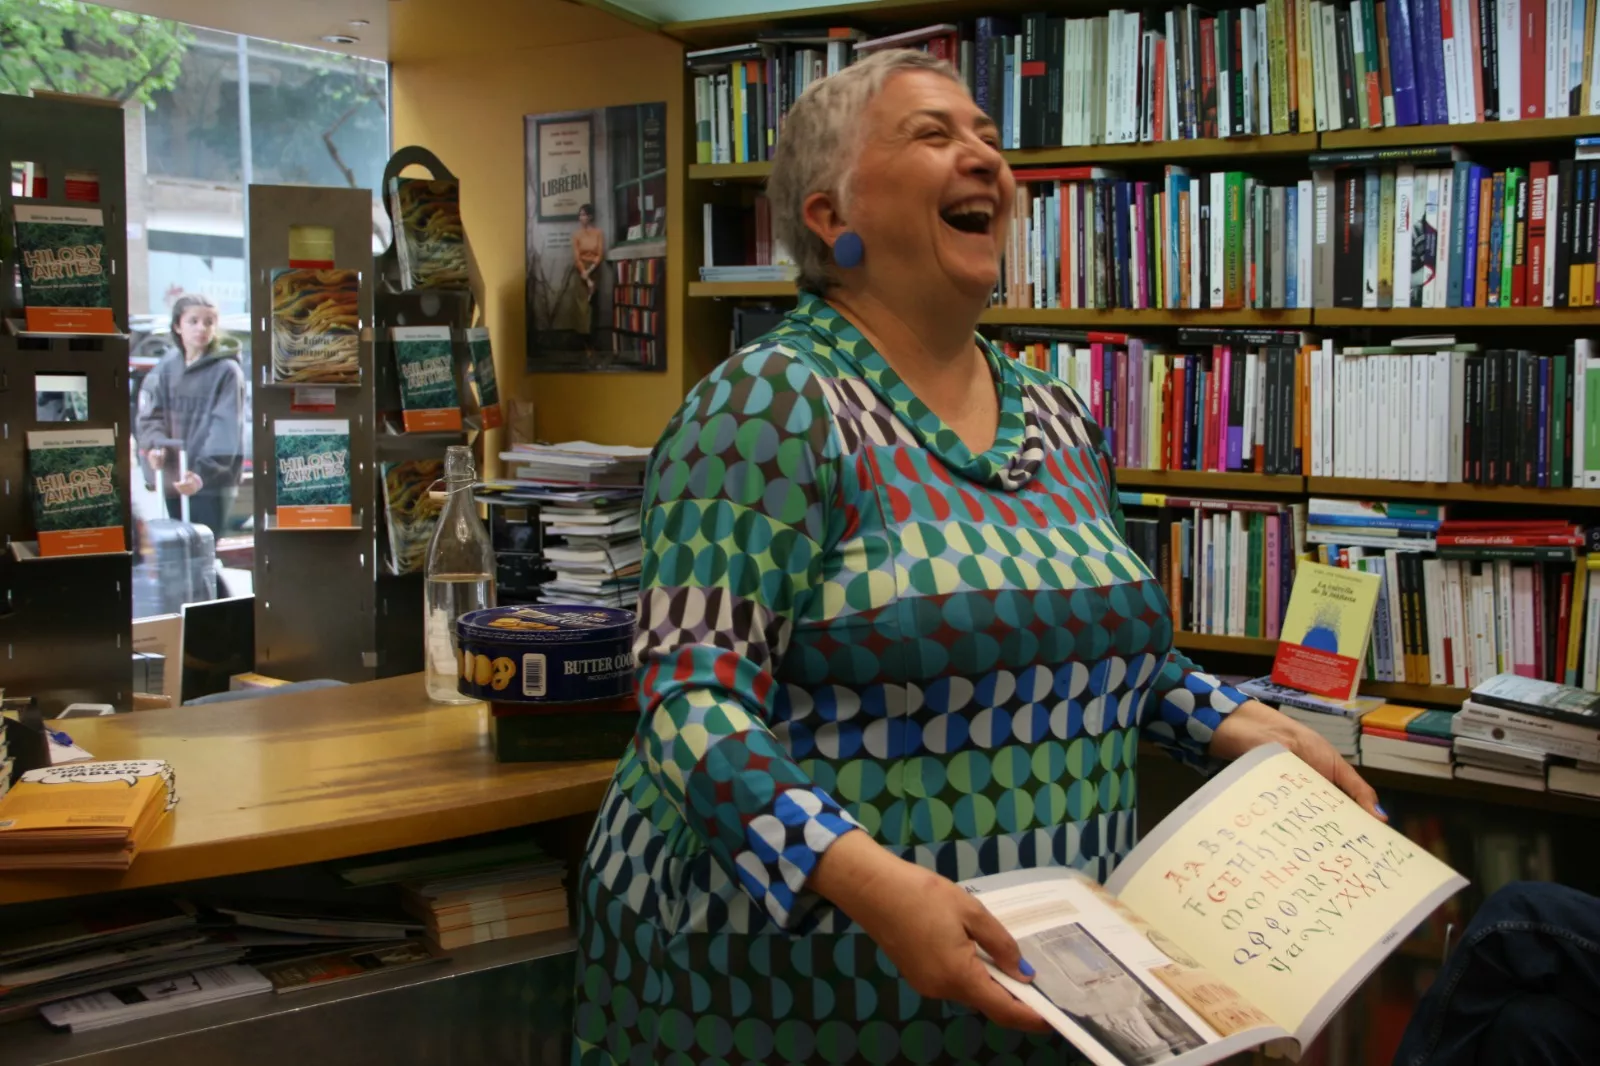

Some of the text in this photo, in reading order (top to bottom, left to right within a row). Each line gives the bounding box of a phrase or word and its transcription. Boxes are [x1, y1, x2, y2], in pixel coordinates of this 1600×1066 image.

[541, 169, 589, 198] LIBRERÍA
[1531, 178, 1546, 221] IGUALDAD
[1396, 194, 1407, 234] Progreso
[24, 246, 86, 268] HILOS
[32, 259, 103, 281] ARTES
[36, 467, 99, 493] HILOS
[284, 462, 346, 485] ARTES
[44, 479, 113, 506] ARTES
[1318, 580, 1327, 589] La
[563, 656, 613, 675] BUTTER
[60, 769, 141, 779] HABLEN
[1288, 806, 1314, 824] K
[1300, 798, 1324, 816] K
[1164, 870, 1190, 894] A
[1184, 861, 1206, 877] A
[1198, 840, 1220, 859] B
[1217, 828, 1236, 841] B
[1258, 791, 1279, 810] D
[1280, 860, 1301, 877] N
[1293, 847, 1312, 863] O
[1309, 824, 1334, 847] P
[1356, 834, 1377, 849] T
[1226, 852, 1256, 875] H
[1334, 853, 1353, 869] S
[1304, 873, 1328, 891] R
[1345, 872, 1377, 898] X
[1207, 883, 1229, 904] G
[1292, 887, 1318, 904] R
[1335, 887, 1360, 910] X
[1183, 896, 1208, 918] F
[1315, 898, 1344, 920] V
[1233, 947, 1260, 965] Q
